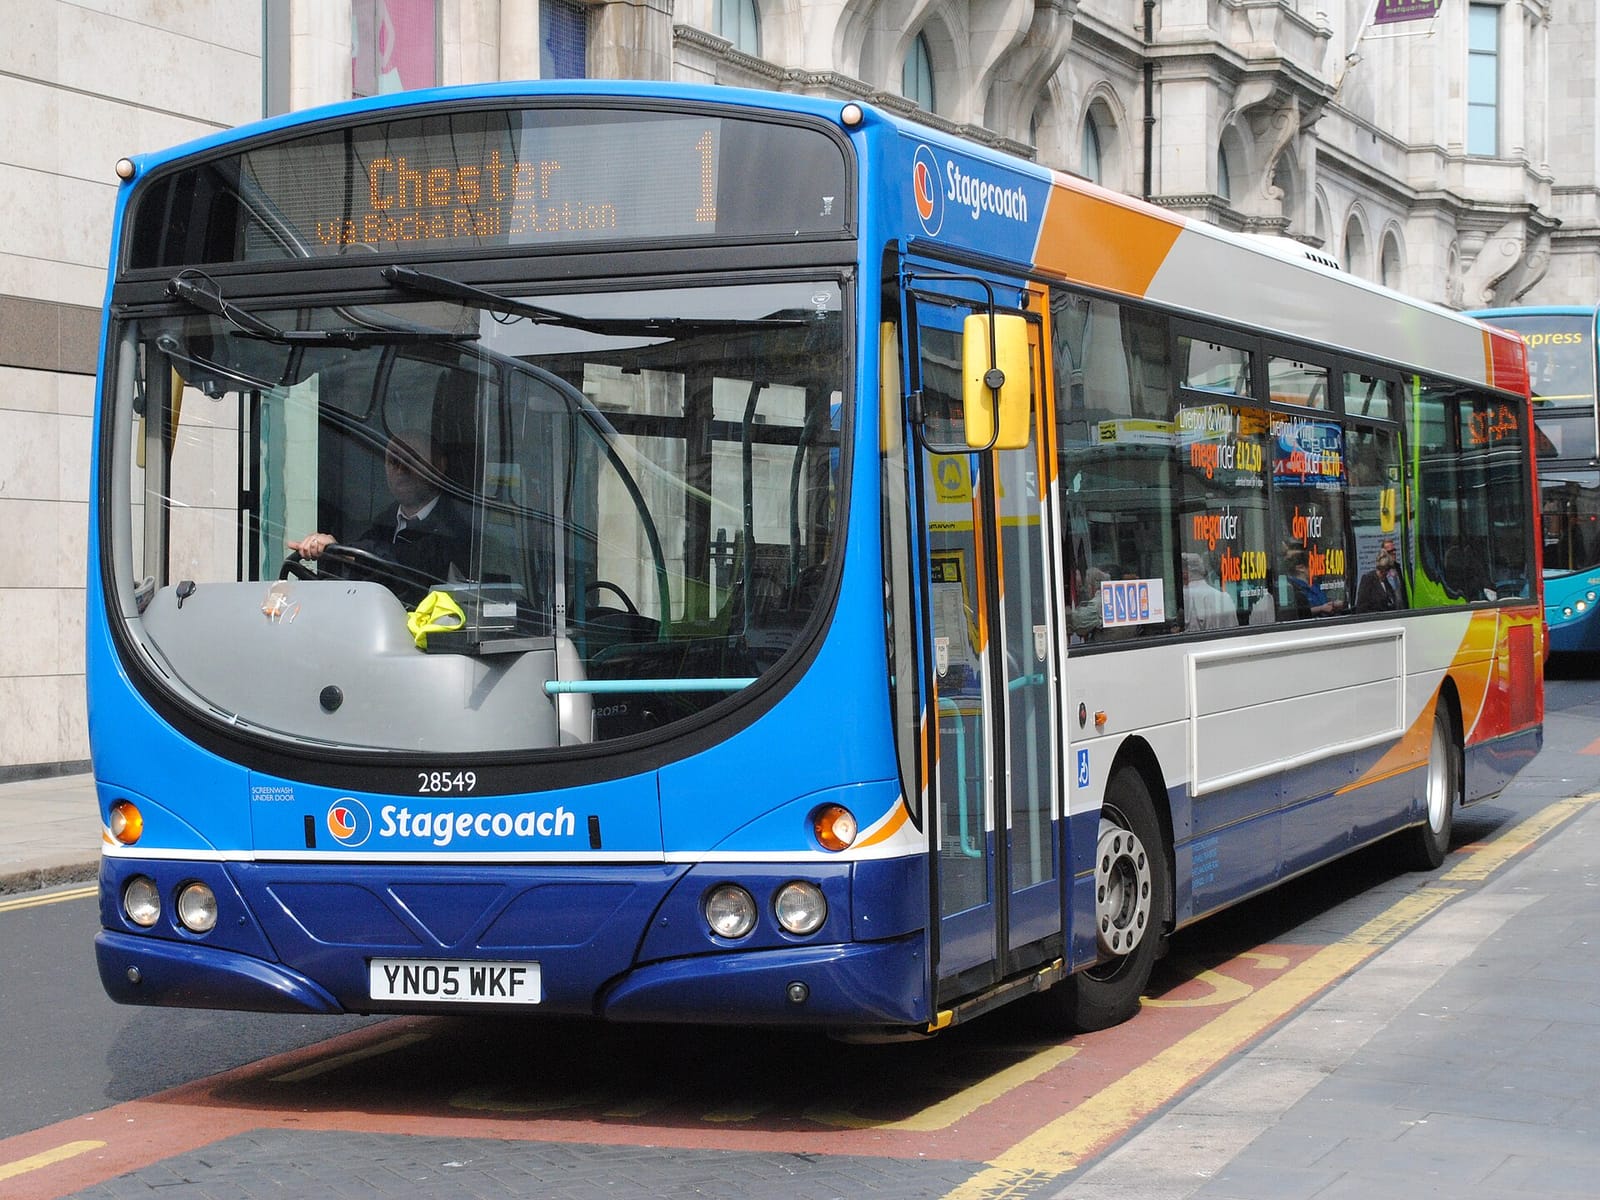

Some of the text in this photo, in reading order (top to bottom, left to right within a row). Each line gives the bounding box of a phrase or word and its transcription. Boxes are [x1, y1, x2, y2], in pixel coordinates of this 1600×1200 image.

[369, 151, 561, 209] Chester
[695, 130, 717, 222] 1
[946, 160, 1028, 223] Stagecoach
[317, 202, 616, 245] via Bache Rail Station
[1522, 332, 1583, 349] xpress
[1191, 436, 1235, 479] megarider
[1236, 441, 1262, 473] £12.50
[1193, 505, 1239, 551] megarider
[1292, 505, 1323, 549] dayrider
[1220, 547, 1267, 593] plus £15.00
[1308, 544, 1325, 588] plus
[1325, 548, 1344, 576] £4.00
[251, 786, 293, 794] SCREENWASH
[252, 794, 295, 802] UNDER DOOR
[417, 771, 477, 793] 28549
[379, 804, 576, 847] Stagecoach
[383, 965, 527, 997] YN05 WKF
